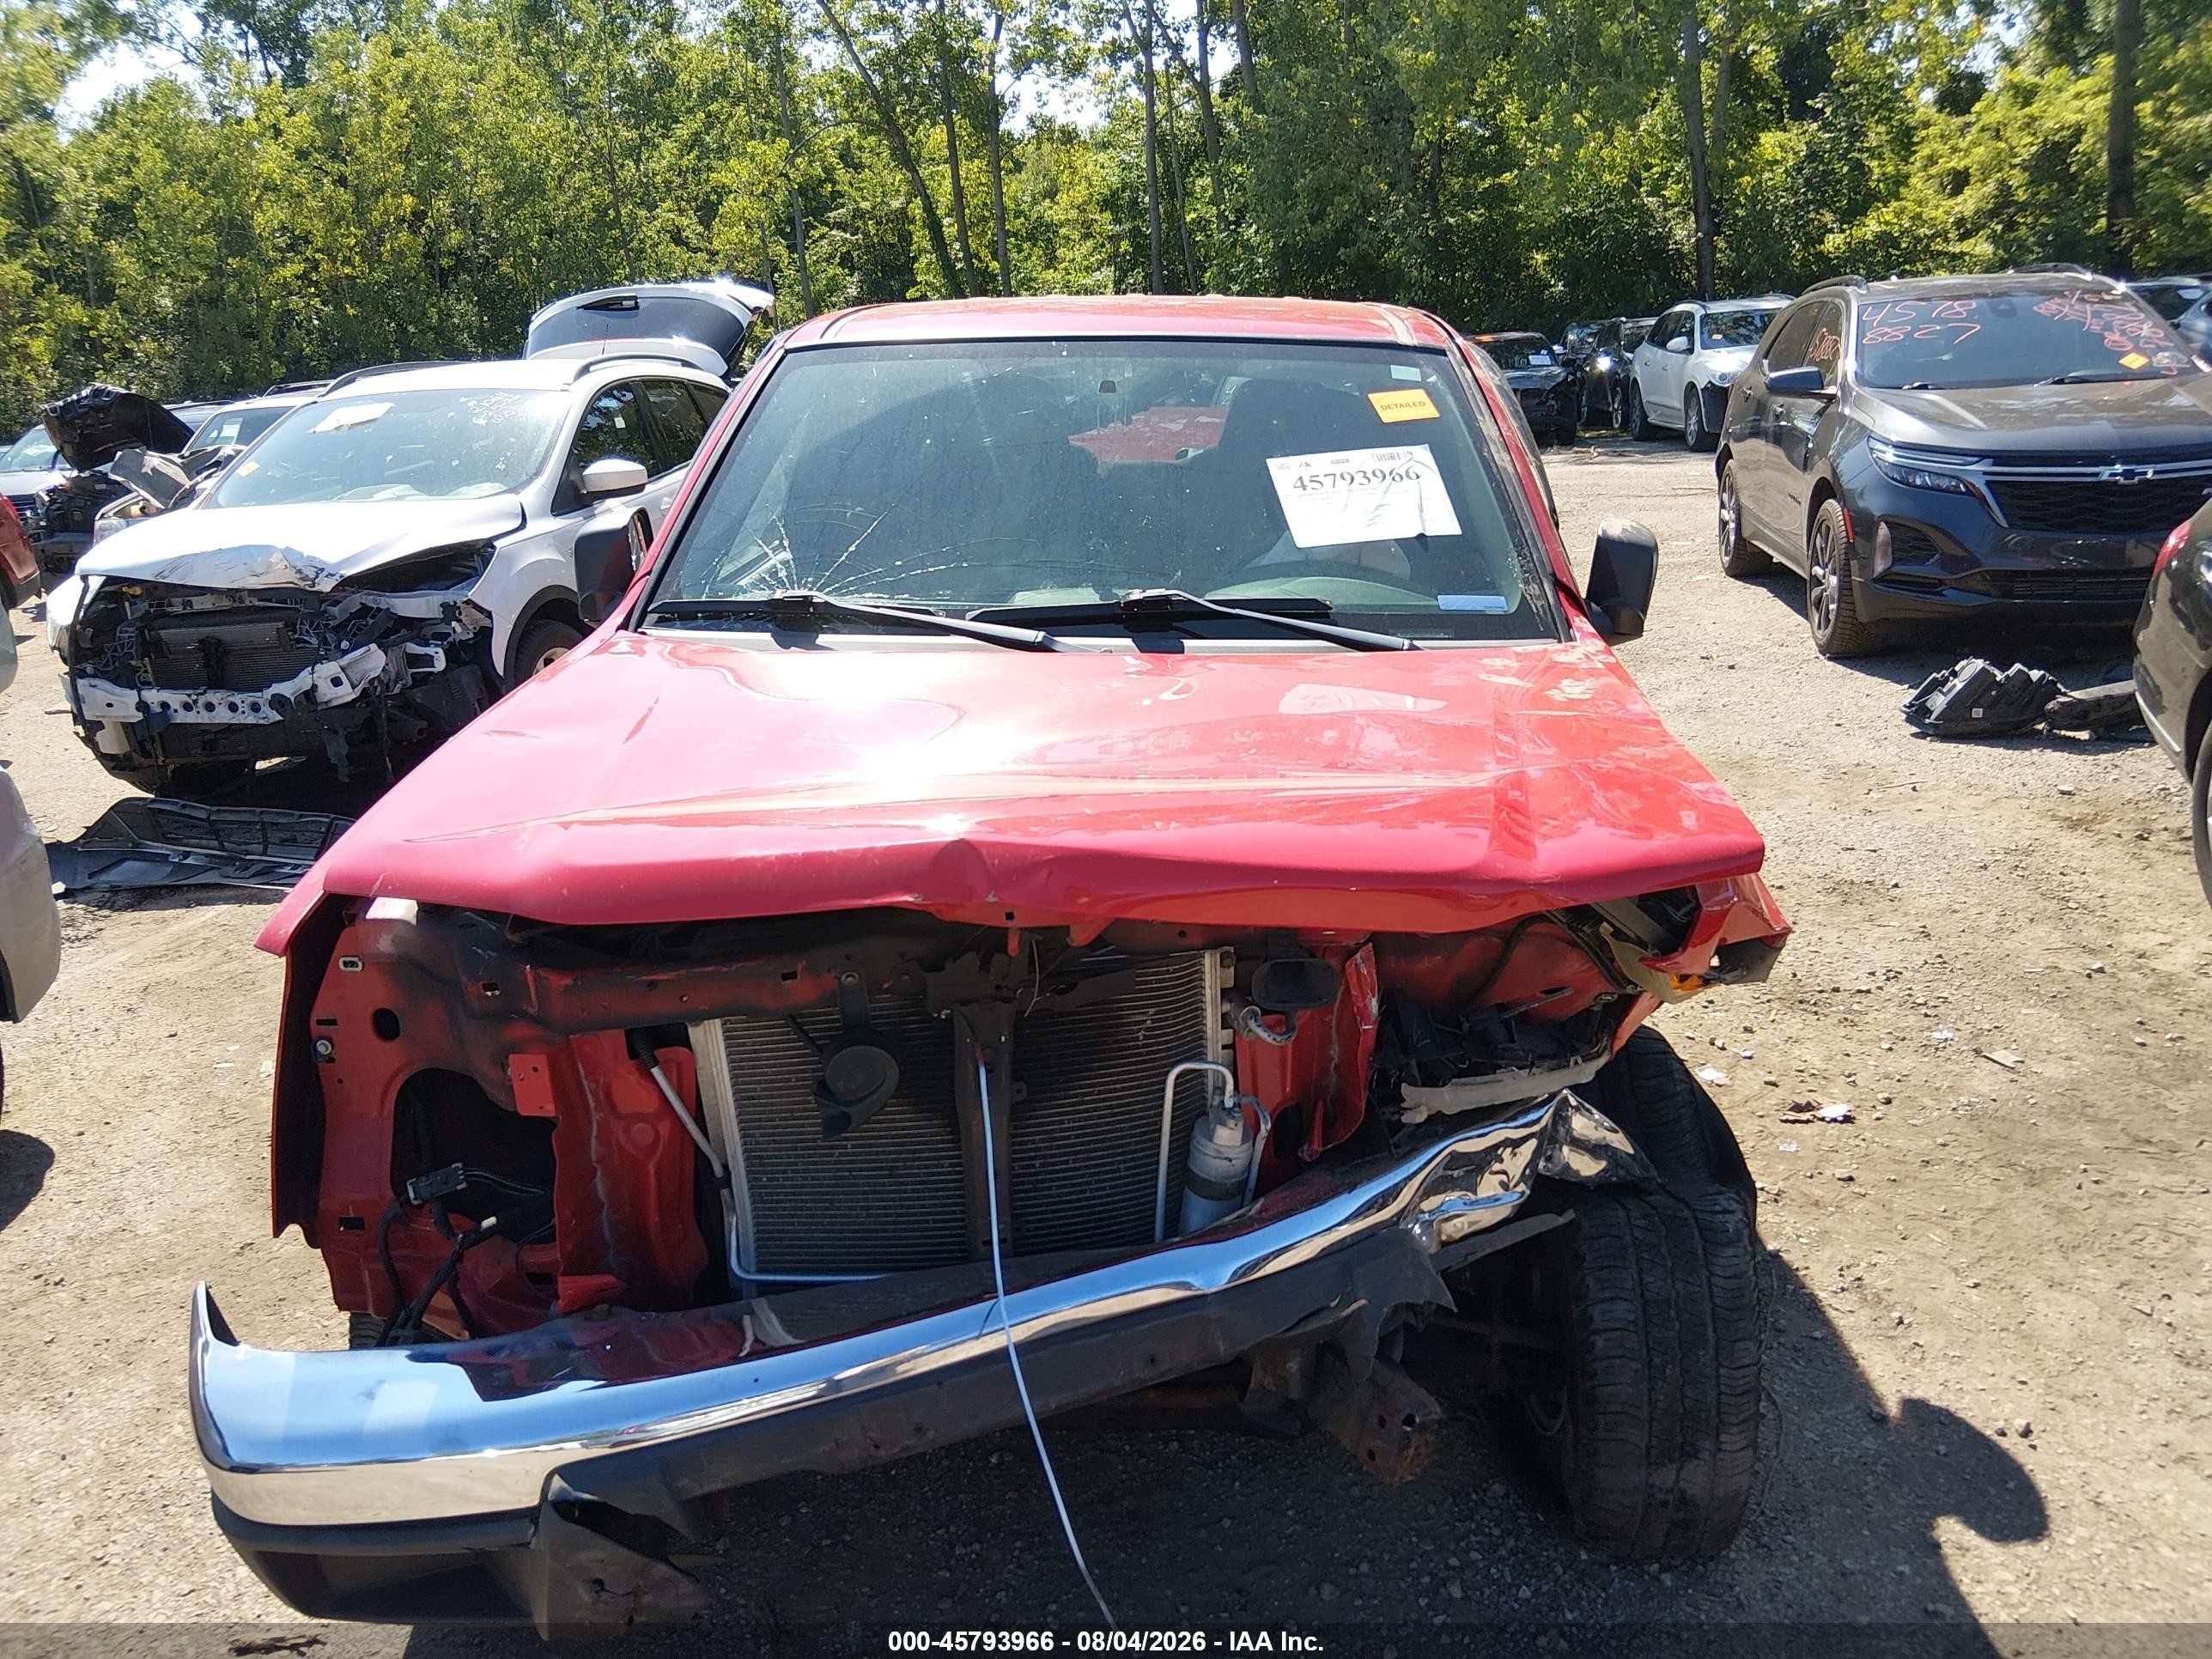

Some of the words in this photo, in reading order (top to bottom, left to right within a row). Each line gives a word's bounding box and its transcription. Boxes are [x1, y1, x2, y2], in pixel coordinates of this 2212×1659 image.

[1863, 323, 1981, 344] 8827
[1380, 401, 1426, 411] DETAILED
[1293, 466, 1421, 491] 45793966
